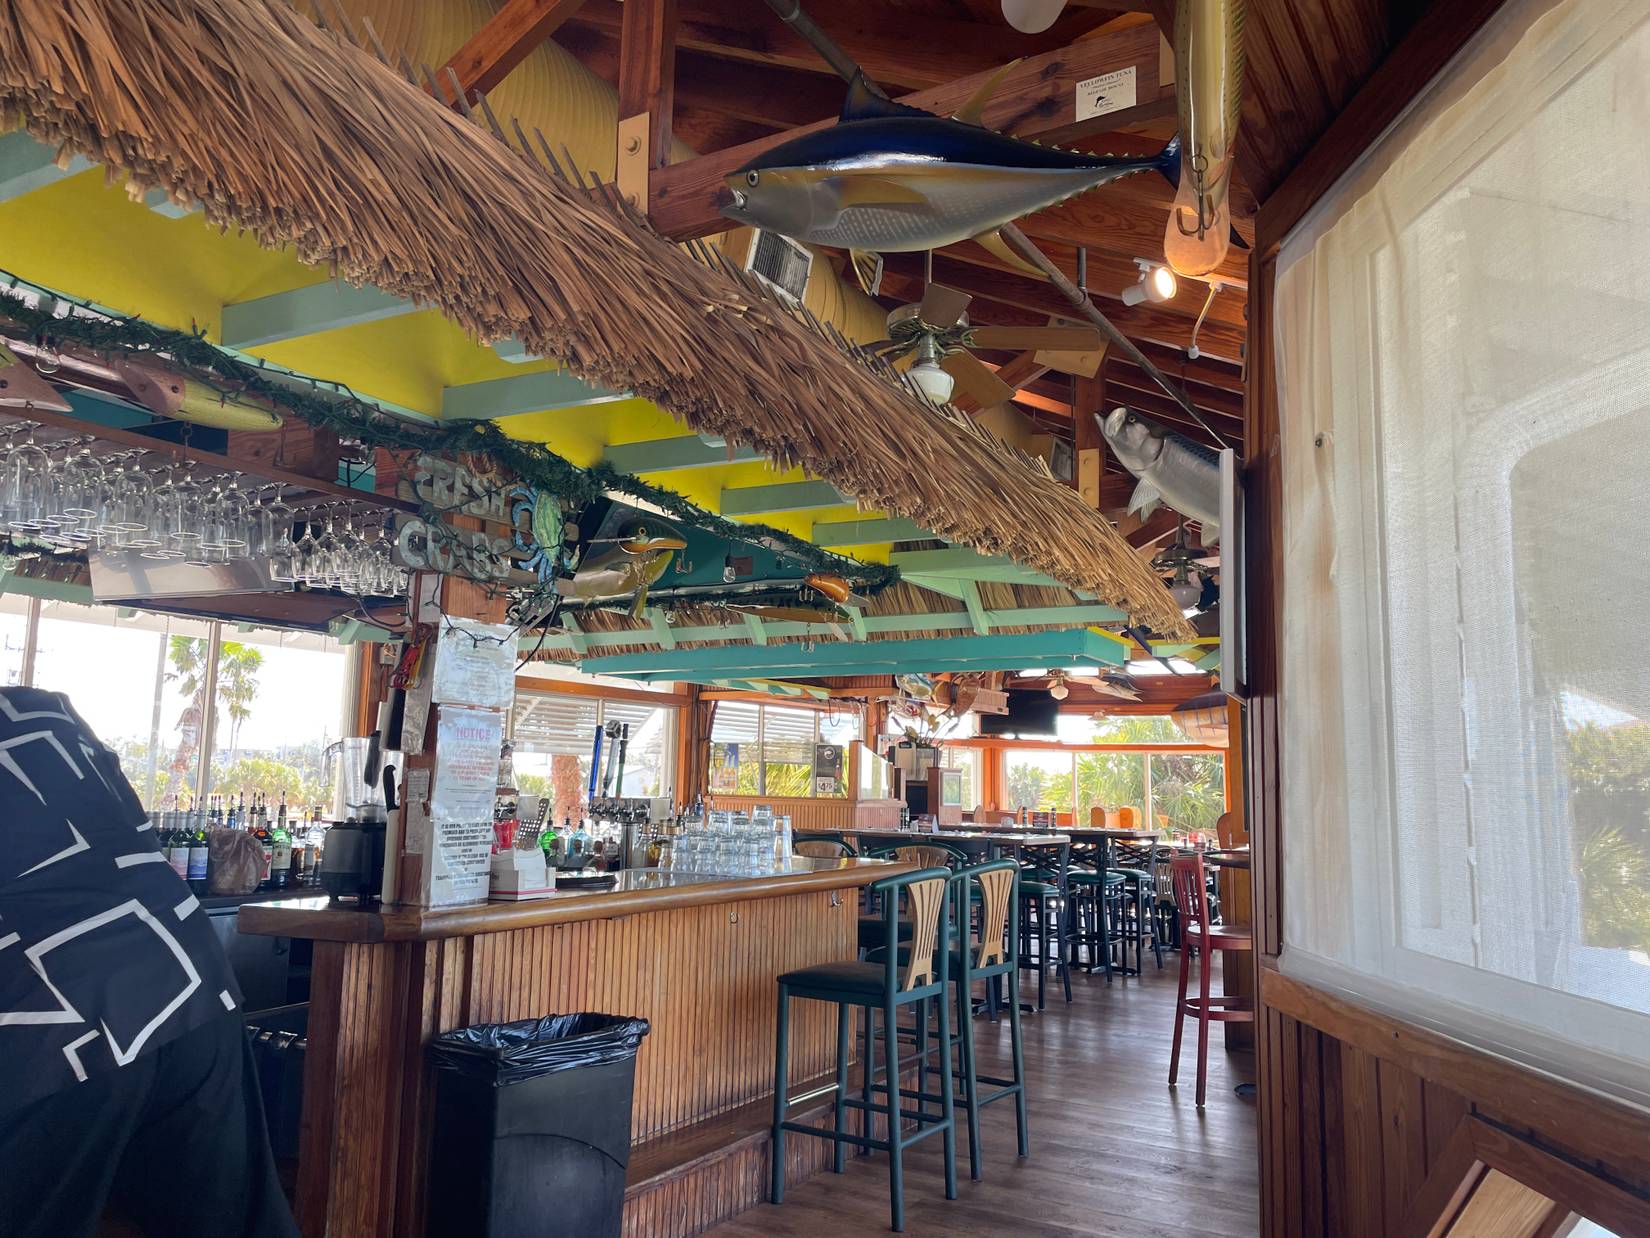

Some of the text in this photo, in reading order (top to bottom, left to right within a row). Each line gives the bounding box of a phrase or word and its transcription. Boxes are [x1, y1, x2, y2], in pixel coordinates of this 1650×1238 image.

[1116, 70, 1132, 79] TUNA
[414, 455, 506, 517] FRESH
[399, 520, 511, 579] CRABS
[456, 727, 491, 740] NOTICE
